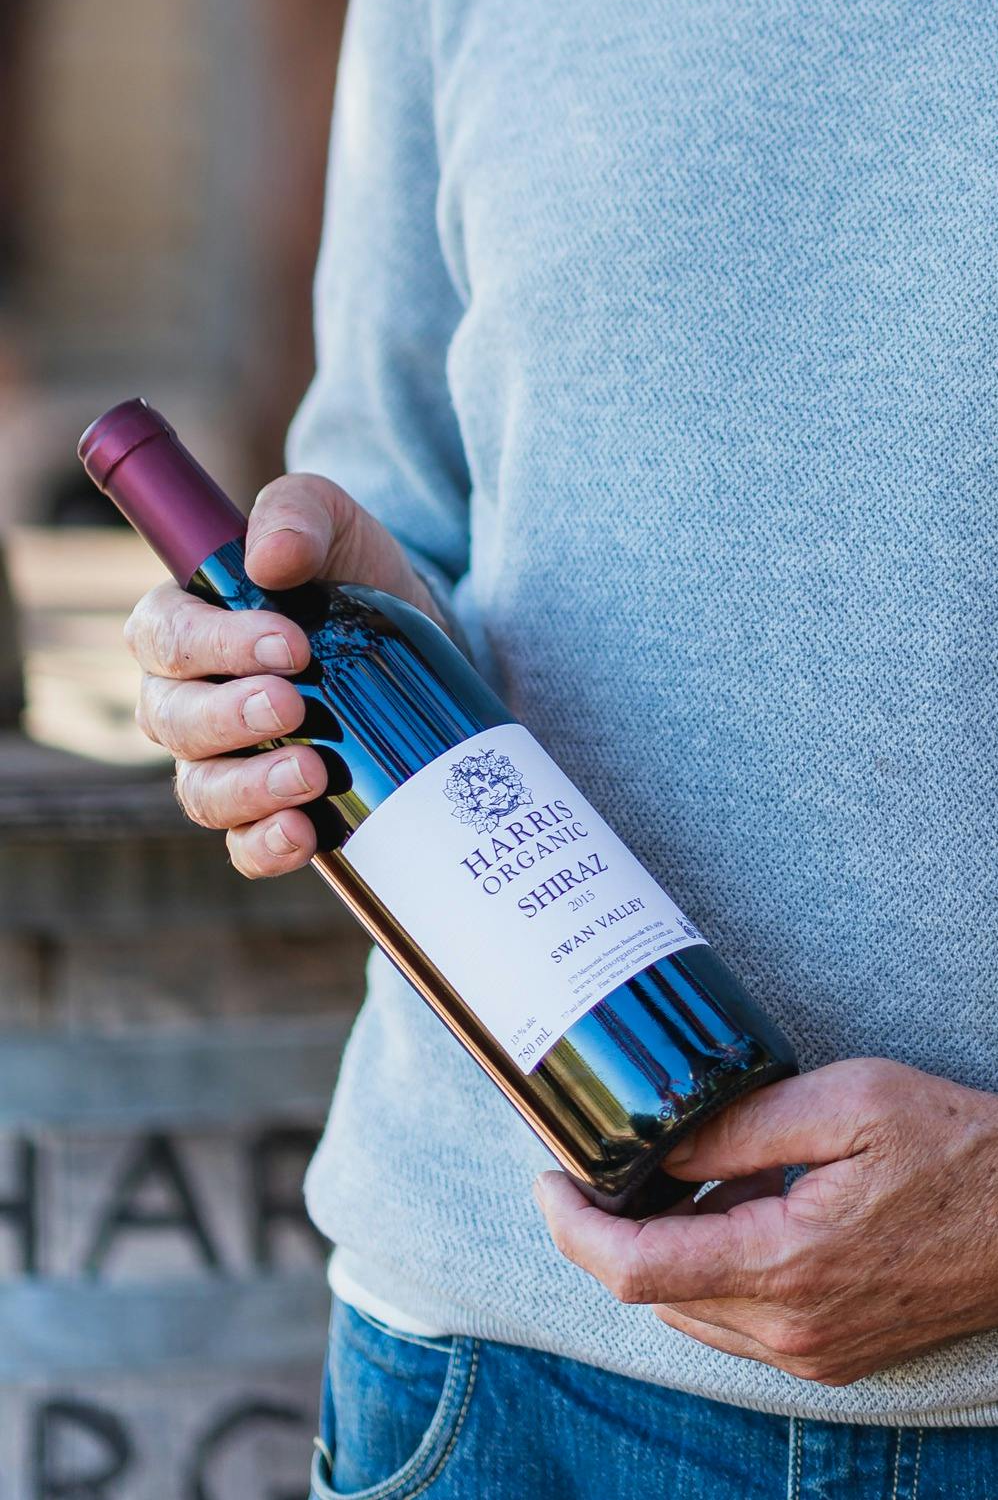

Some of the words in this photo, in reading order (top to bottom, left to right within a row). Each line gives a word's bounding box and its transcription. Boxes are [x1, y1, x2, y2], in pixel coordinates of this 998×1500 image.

[460, 800, 573, 880] HARRIS
[482, 822, 588, 895] ORGANIC
[517, 853, 608, 918] SHIRAZ
[567, 889, 596, 912] 2015
[550, 925, 596, 964] SWAN
[595, 897, 646, 929] VALLEY
[511, 1034, 520, 1045] 13
[526, 1016, 537, 1029] alc
[518, 1043, 536, 1064] 750
[535, 1027, 553, 1046] mL
